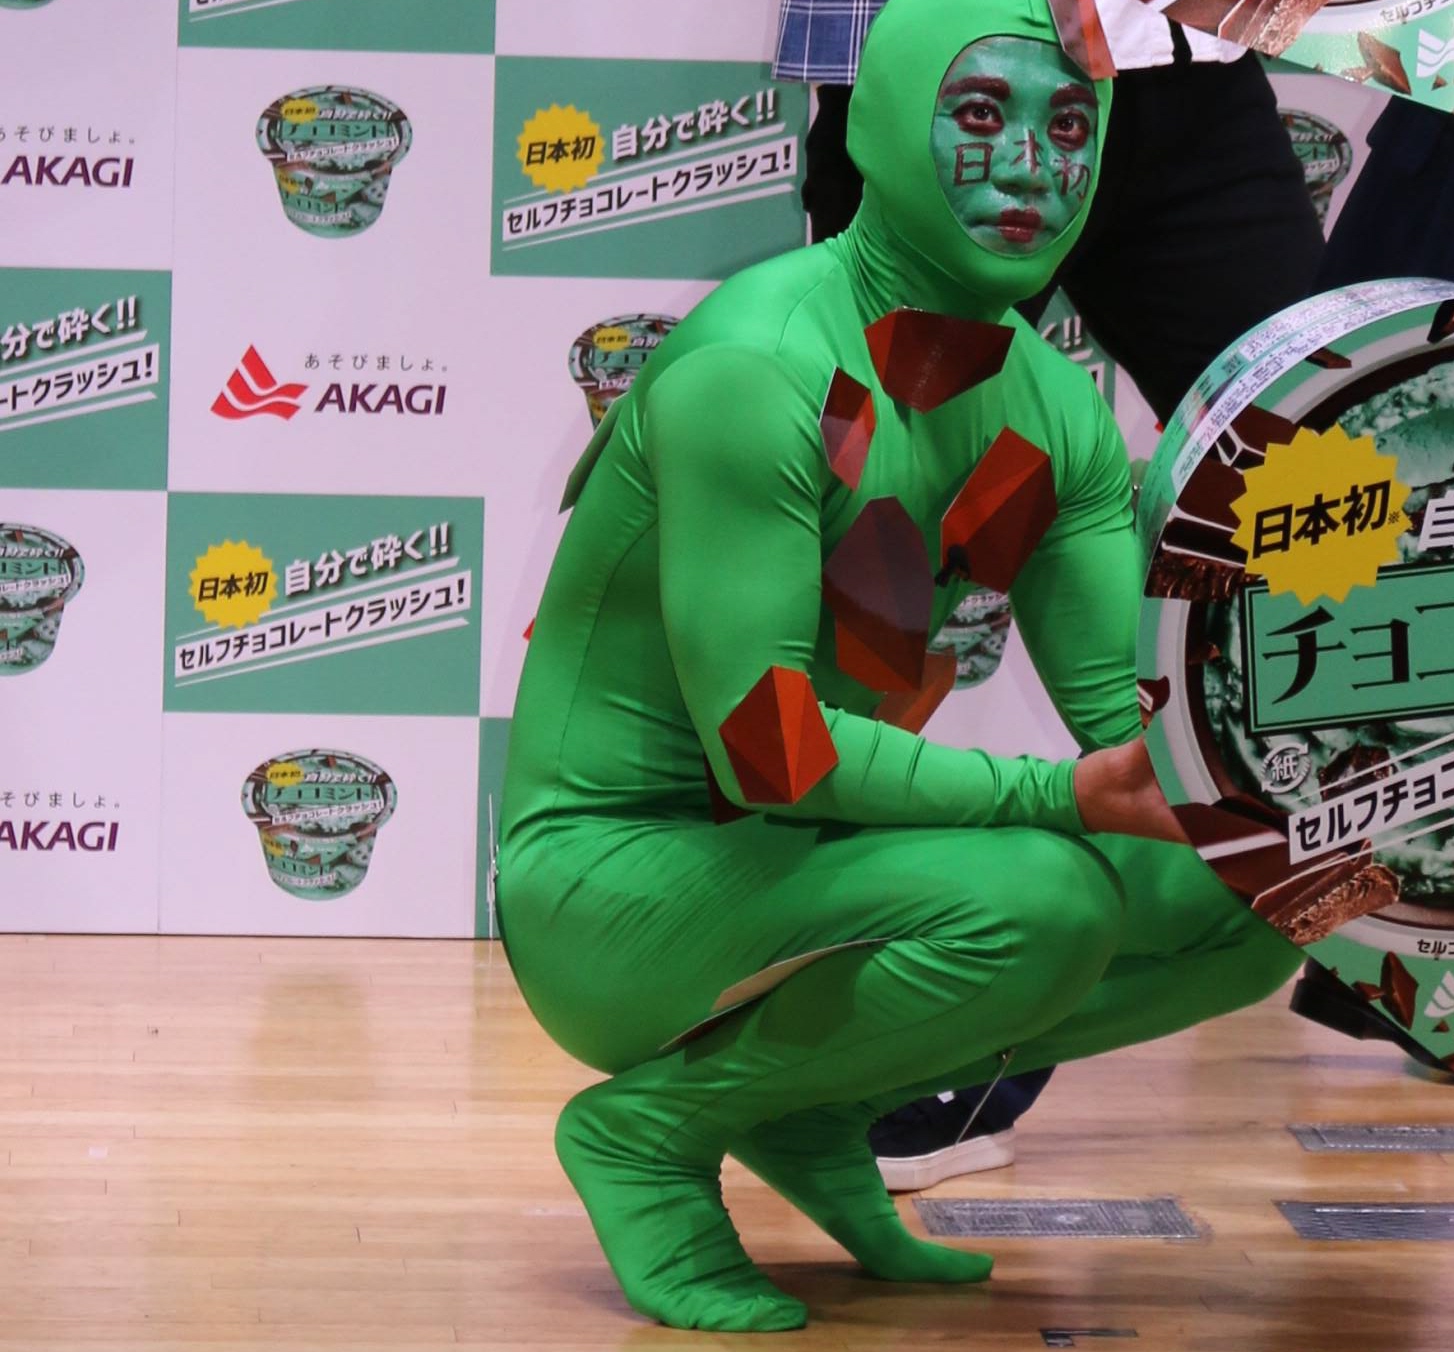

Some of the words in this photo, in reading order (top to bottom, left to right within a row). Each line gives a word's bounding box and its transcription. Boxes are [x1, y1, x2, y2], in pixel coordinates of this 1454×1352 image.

[525, 135, 596, 166] 日本初
[0, 154, 134, 187] AKAGI
[313, 382, 447, 415] AKAGI
[197, 570, 269, 602] 日本初
